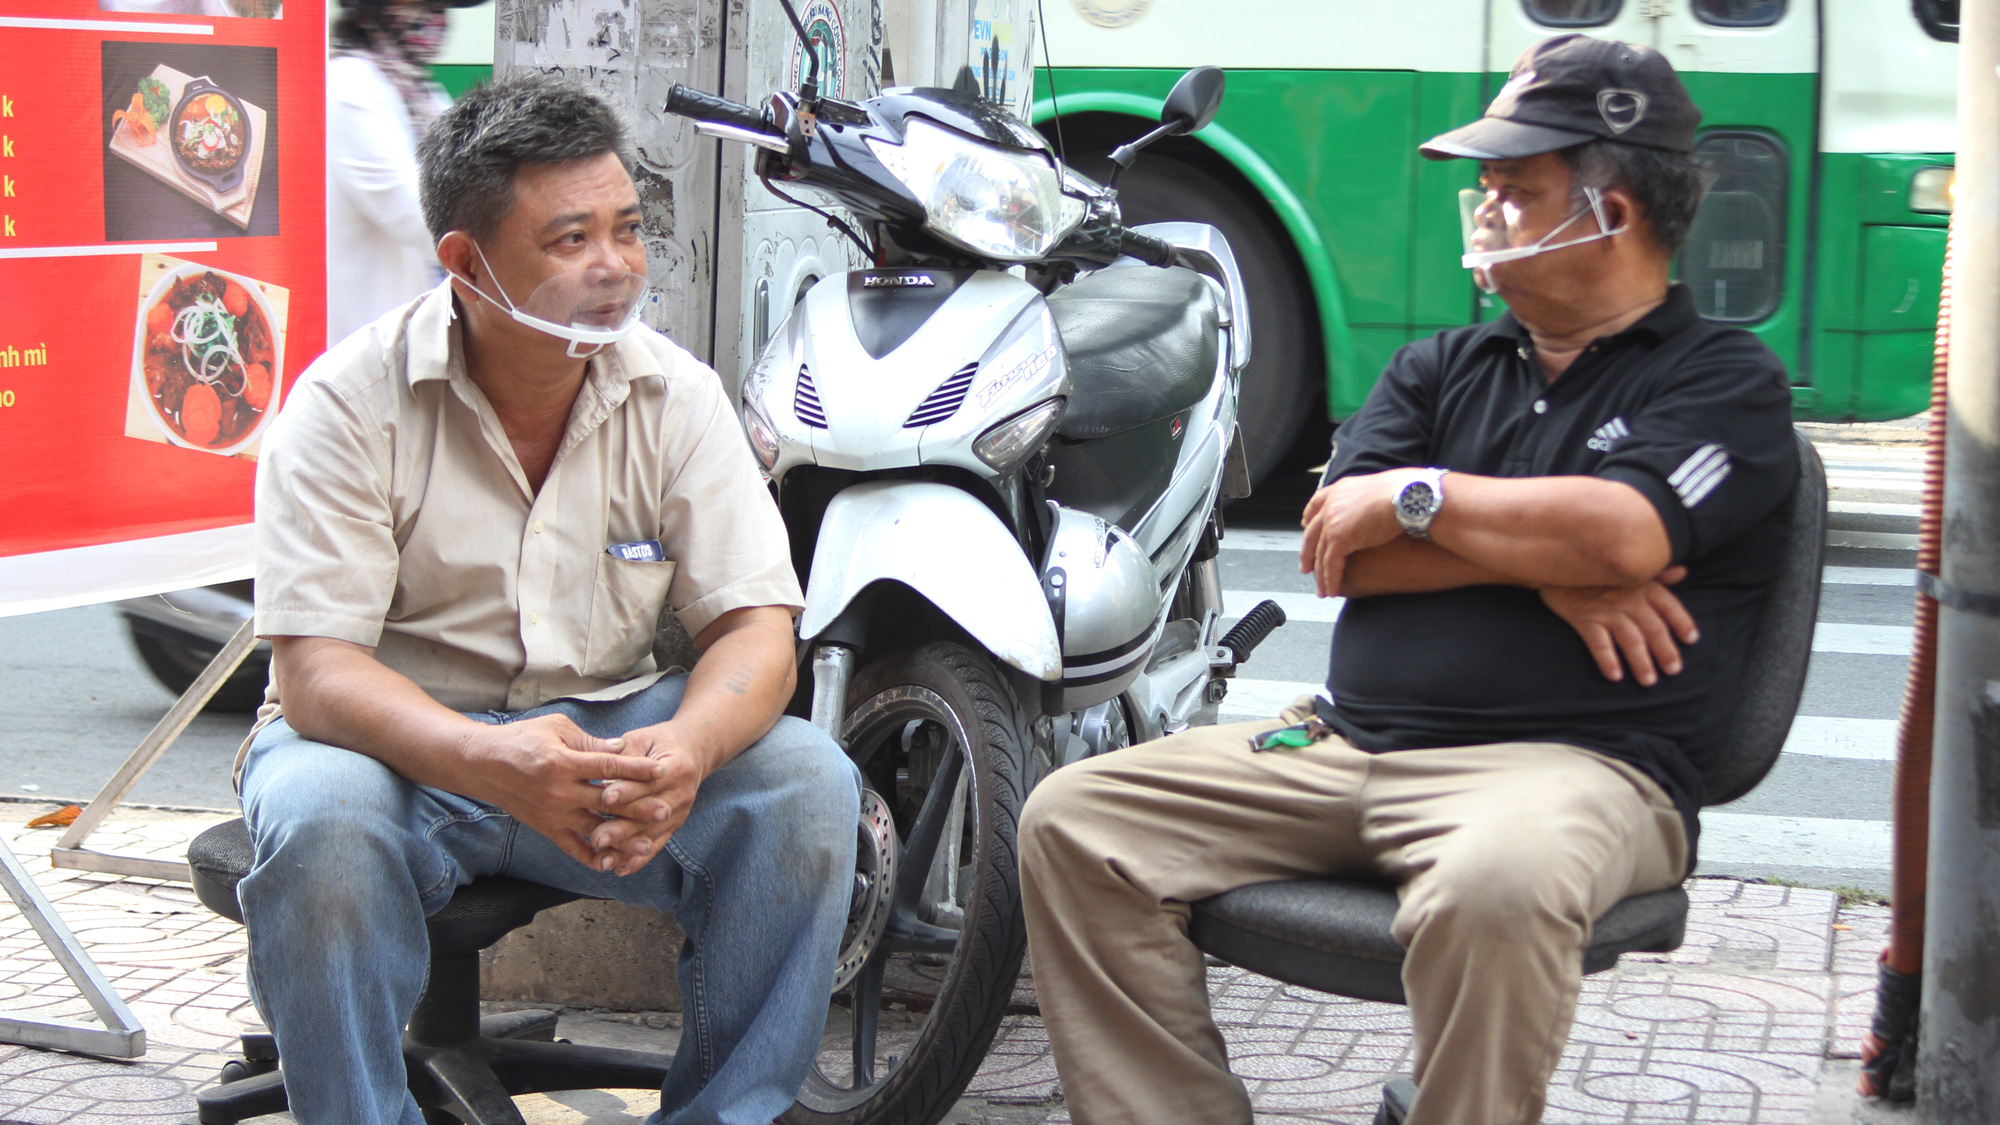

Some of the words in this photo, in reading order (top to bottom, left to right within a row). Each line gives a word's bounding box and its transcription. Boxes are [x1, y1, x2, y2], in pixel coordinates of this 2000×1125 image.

[974, 20, 991, 41] EVN
[2, 95, 14, 117] k
[3, 135, 15, 157] k
[4, 175, 16, 197] k
[4, 215, 16, 237] k
[863, 276, 934, 287] HONDA
[24, 343, 47, 366] mì
[0, 390, 15, 408] o
[621, 544, 653, 560] BASTOS
